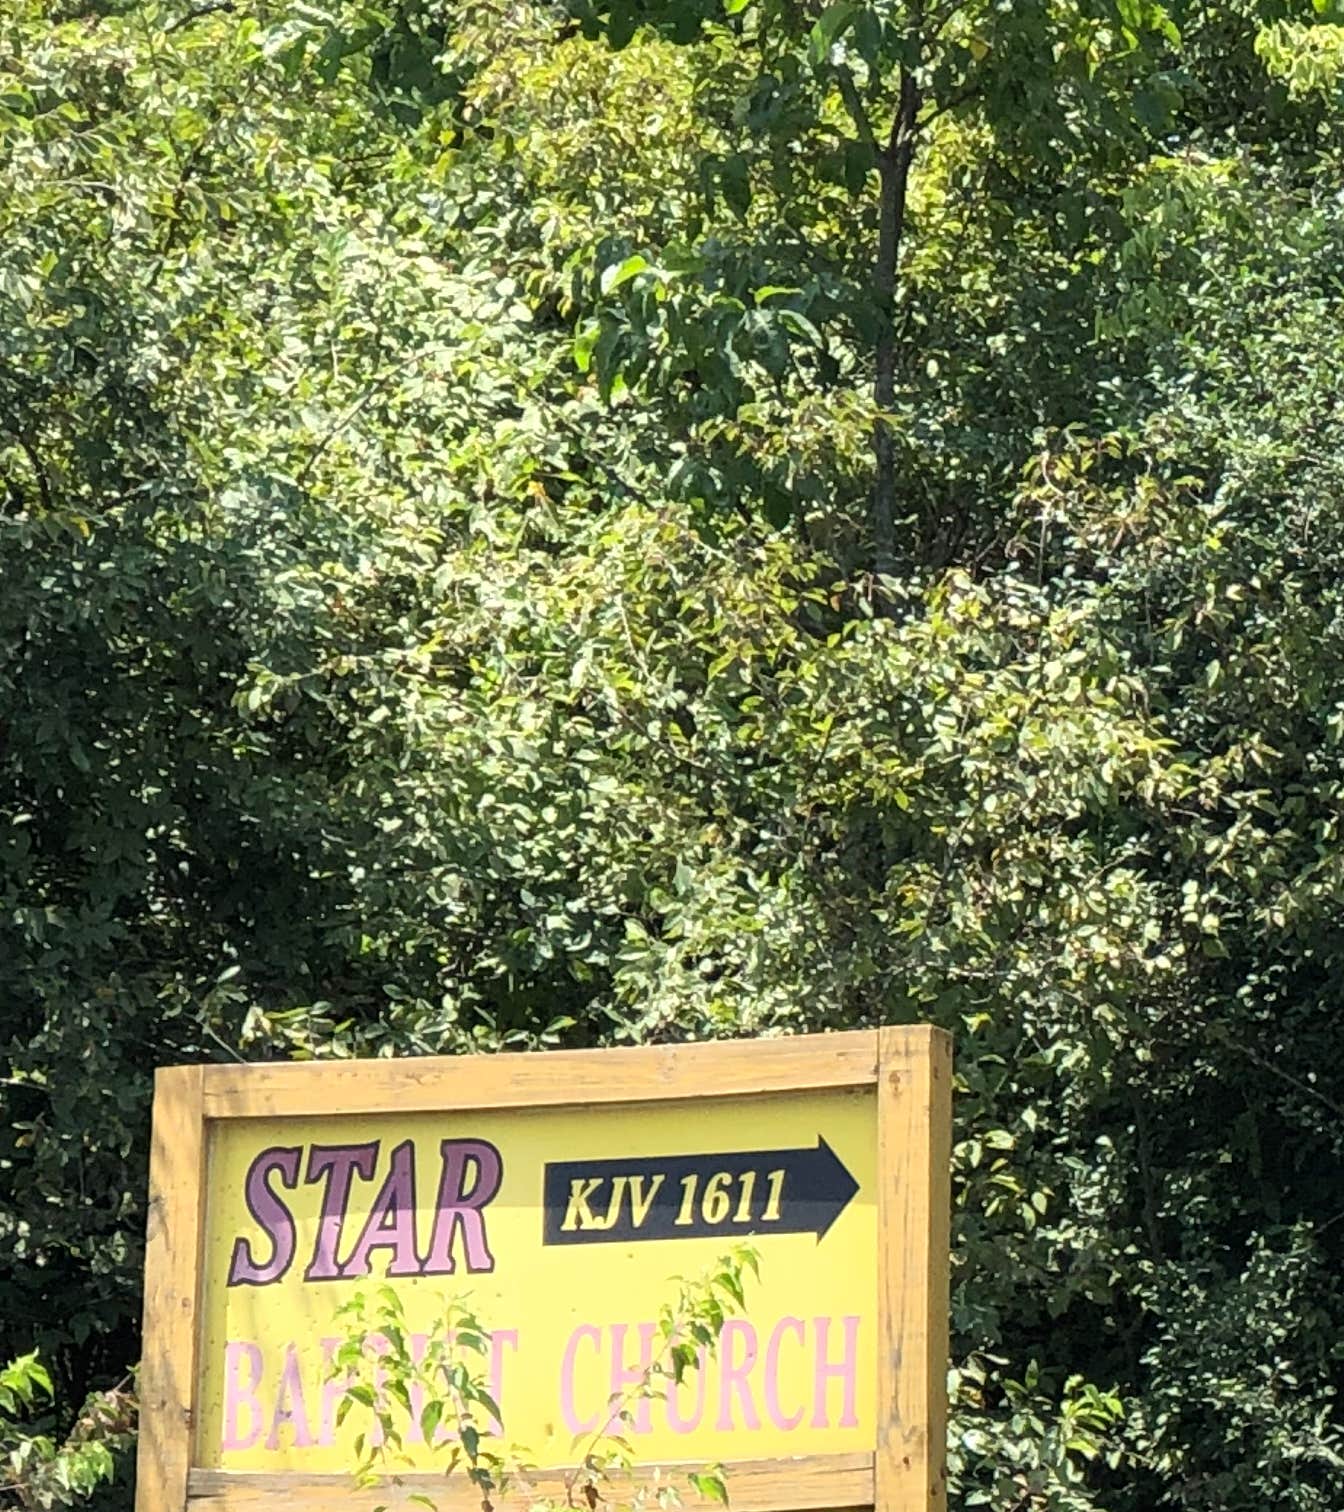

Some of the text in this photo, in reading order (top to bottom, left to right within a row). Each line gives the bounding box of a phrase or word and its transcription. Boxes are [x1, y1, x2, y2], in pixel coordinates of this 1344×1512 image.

[226, 1137, 504, 1287] STAR
[559, 1168, 786, 1233] KJV 1611
[560, 1315, 861, 1435] CHURCH
